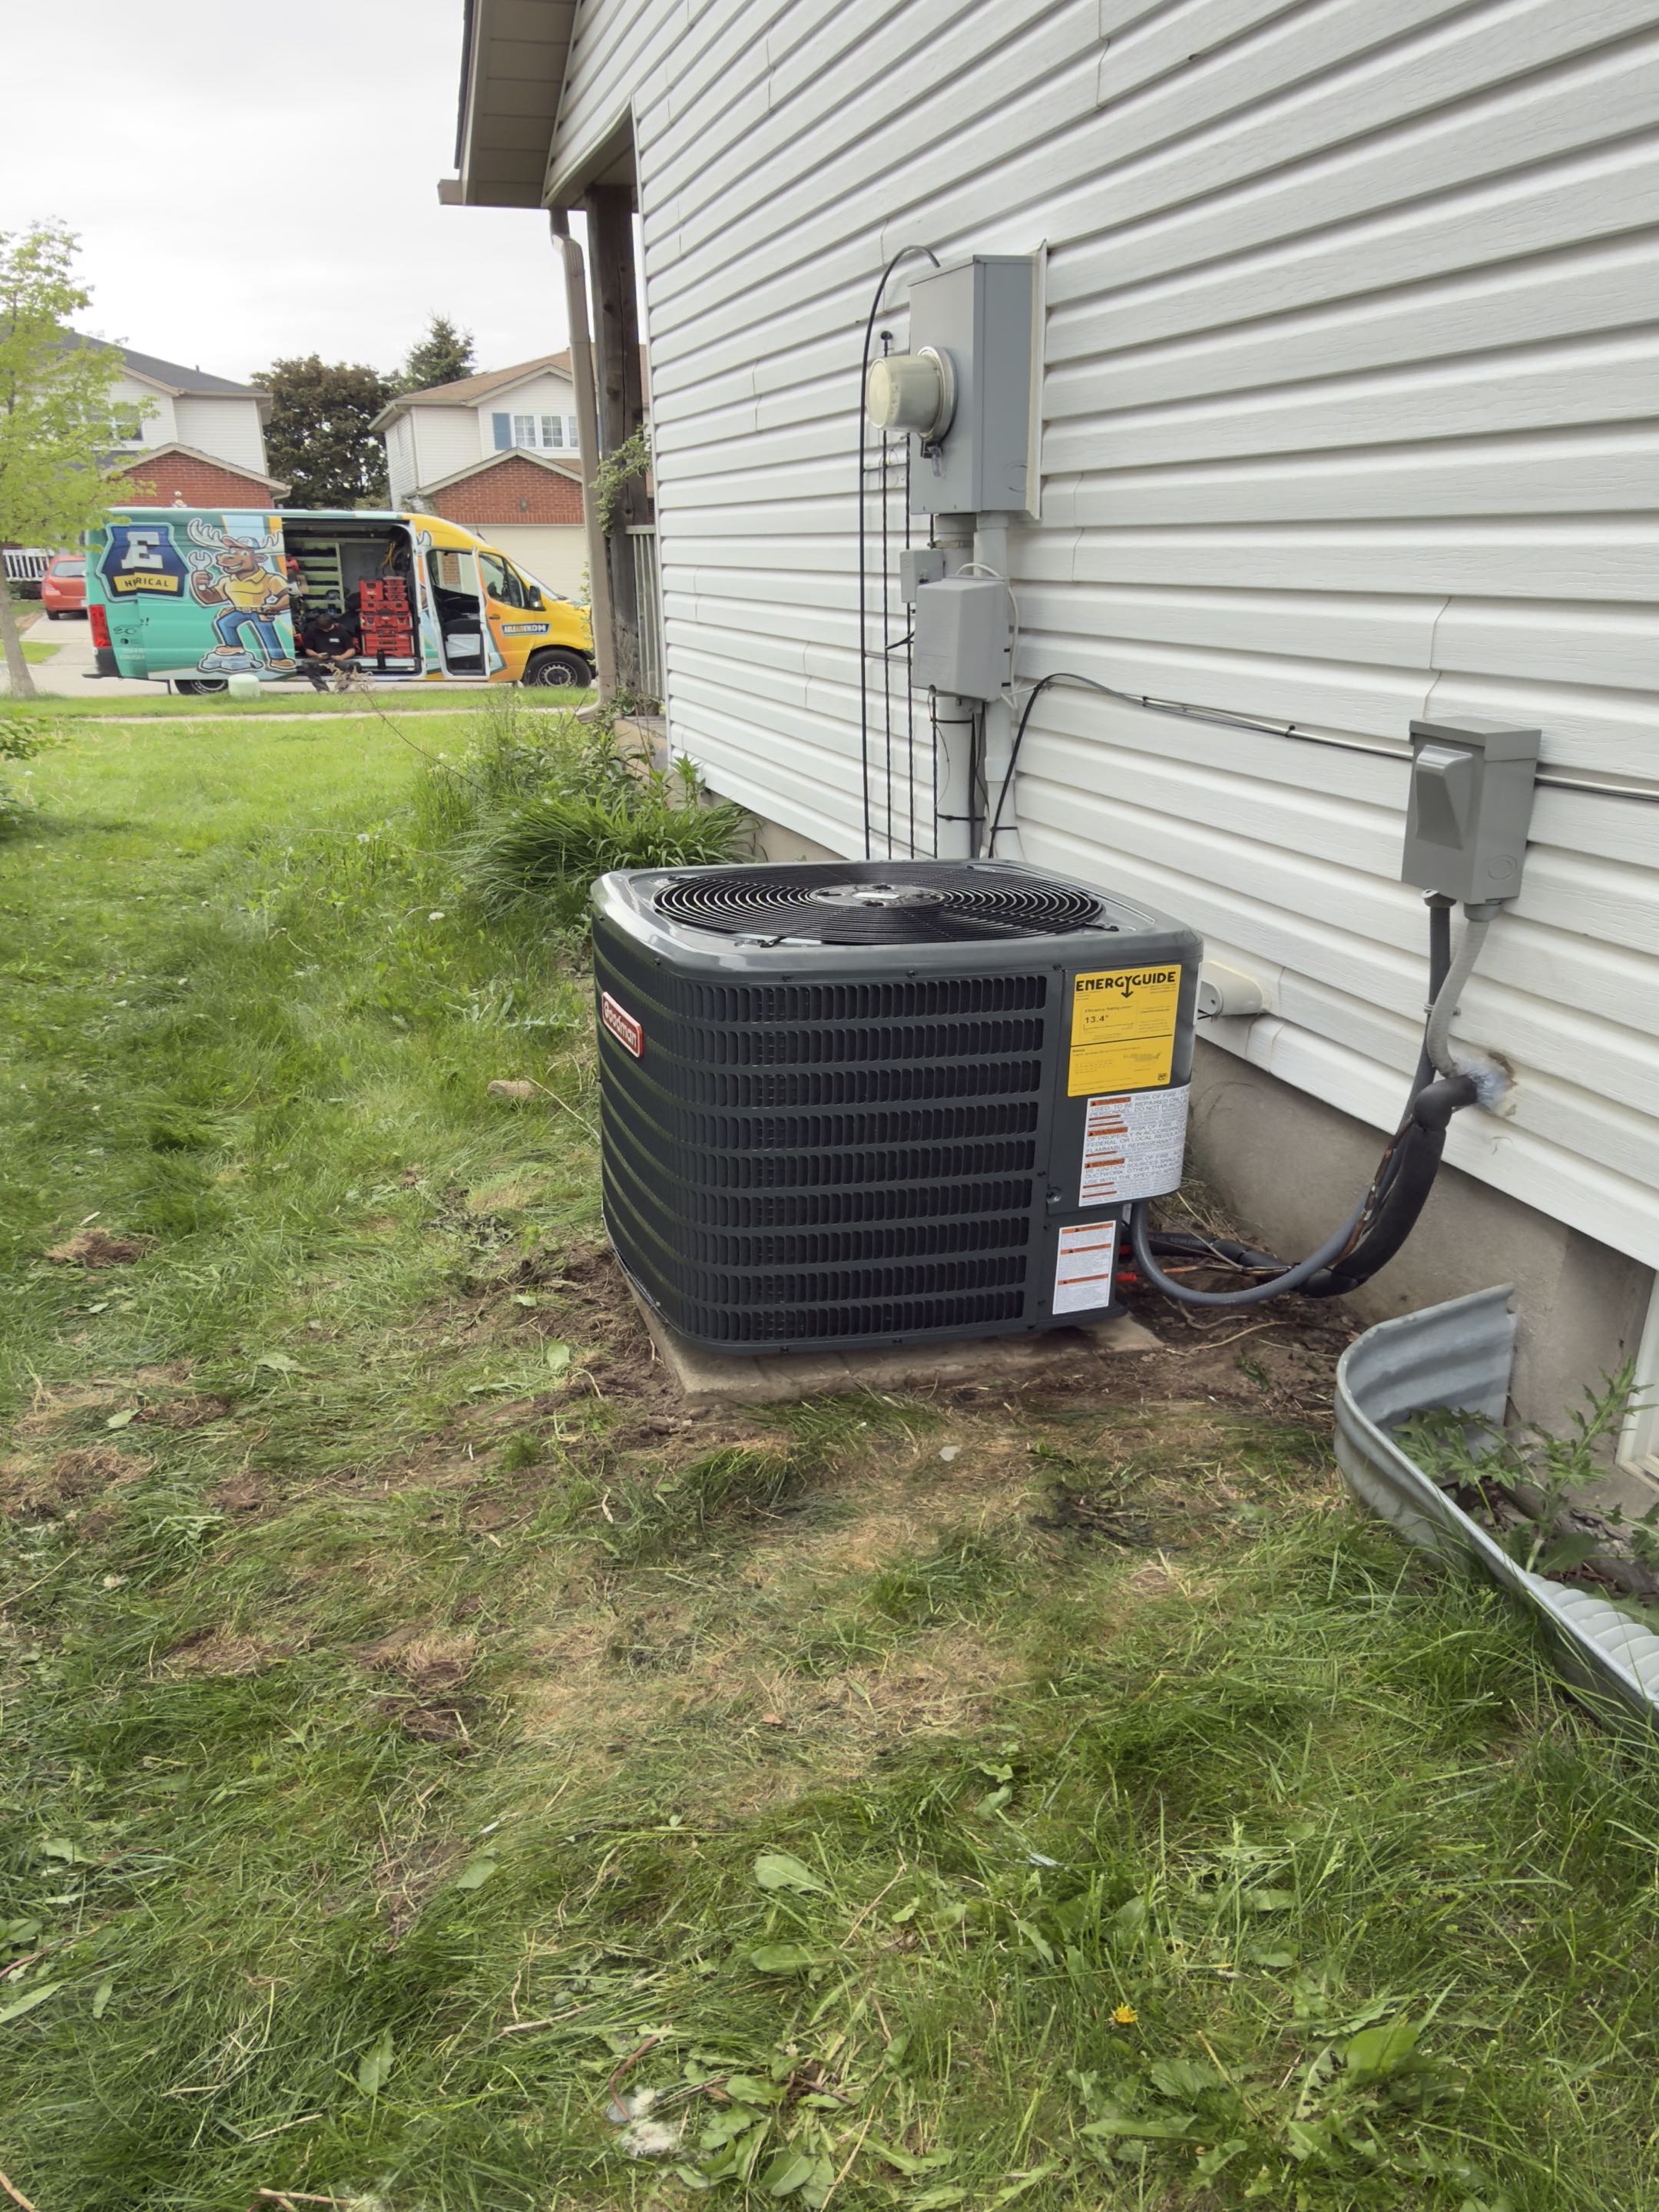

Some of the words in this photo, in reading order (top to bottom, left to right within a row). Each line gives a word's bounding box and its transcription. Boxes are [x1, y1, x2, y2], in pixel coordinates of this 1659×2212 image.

[121, 531, 164, 569] E
[1076, 972, 1176, 995] ENERGYGUIDE
[604, 1001, 637, 1048] Goodman
